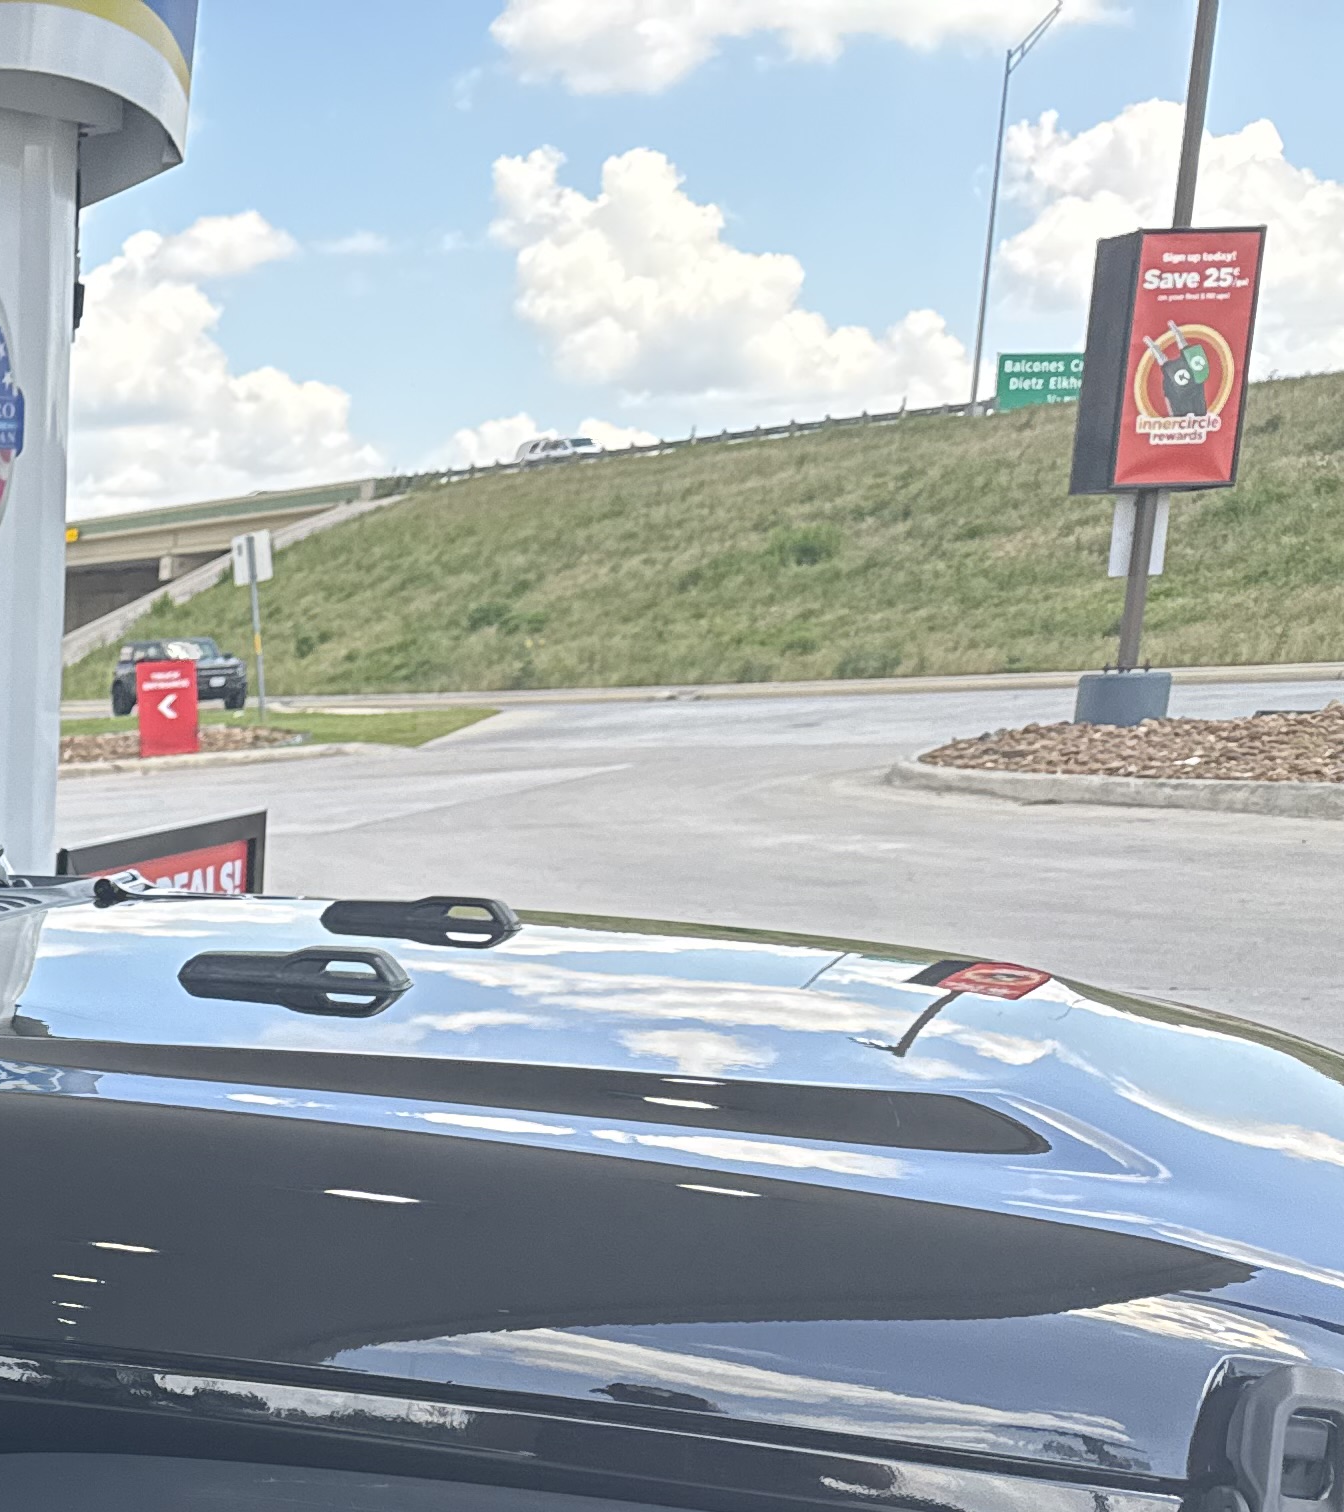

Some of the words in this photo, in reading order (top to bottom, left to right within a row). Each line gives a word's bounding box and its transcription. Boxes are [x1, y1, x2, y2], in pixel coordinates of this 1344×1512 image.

[1143, 268, 1200, 289] Save
[1004, 360, 1065, 373] Balcones
[1009, 376, 1044, 390] Dietz
[1139, 416, 1218, 430] innercircle
[1152, 430, 1203, 441] rewards
